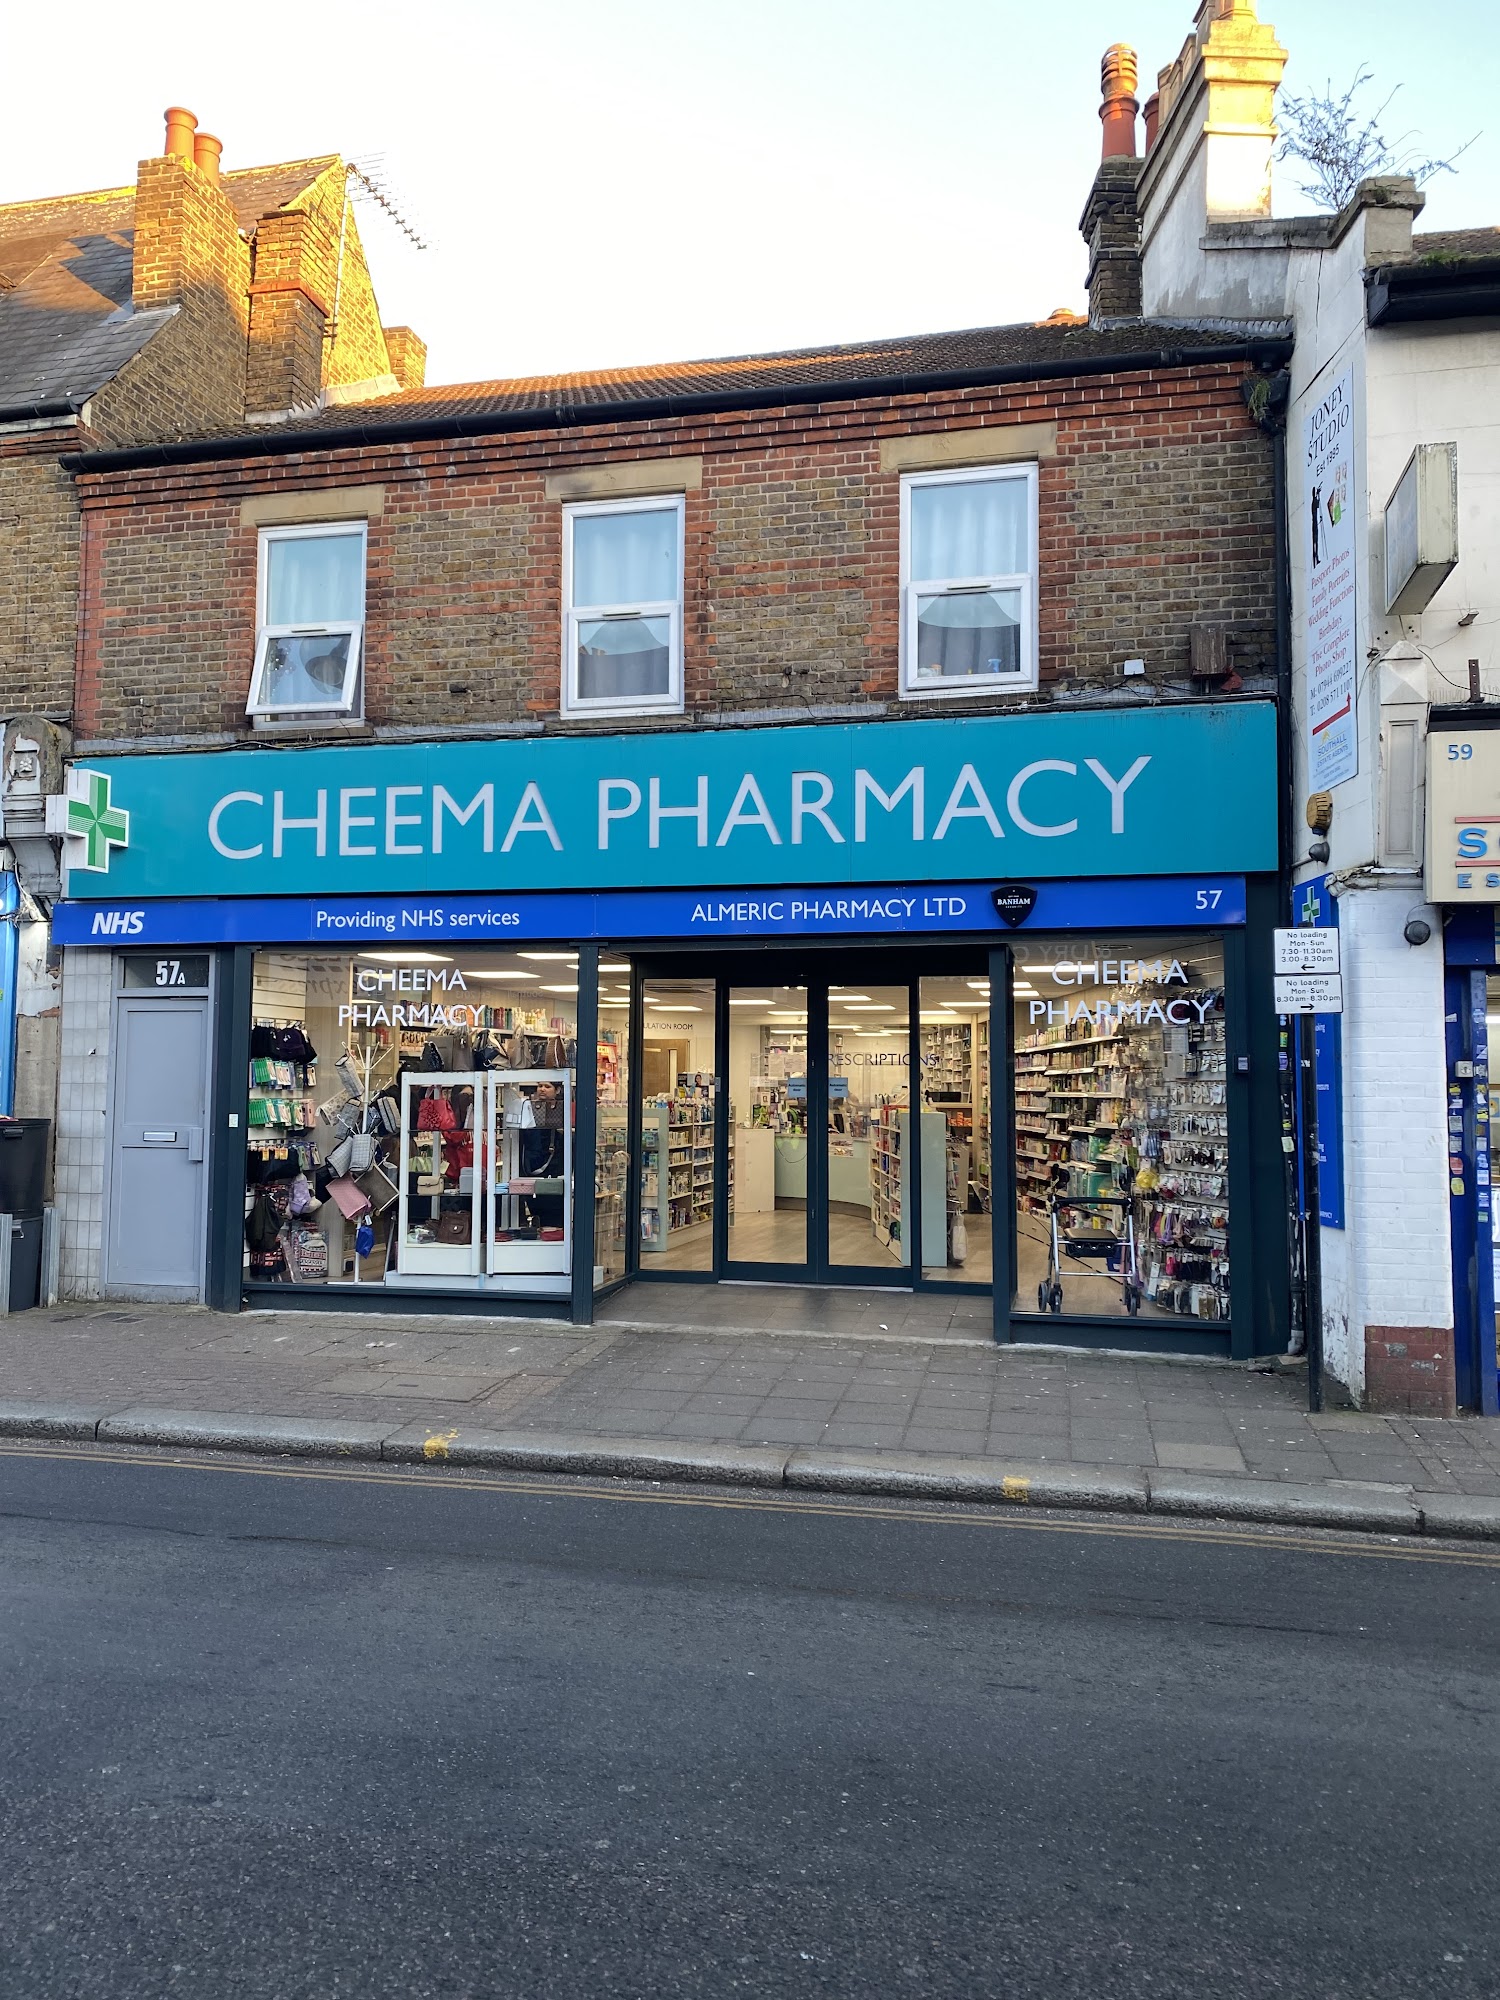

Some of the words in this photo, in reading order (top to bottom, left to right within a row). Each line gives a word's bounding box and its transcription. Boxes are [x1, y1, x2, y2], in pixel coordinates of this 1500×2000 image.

[1309, 378, 1346, 444] JONEY
[1307, 404, 1350, 467] STUDIO
[1316, 460, 1326, 477] Est
[1326, 443, 1340, 466] 1995
[1311, 565, 1331, 590] Passport
[1331, 548, 1350, 570] Photos
[1312, 587, 1328, 608] Family
[1328, 567, 1350, 593] Portraits
[1308, 604, 1329, 628] Wedding
[1329, 582, 1354, 611] Functions
[1318, 615, 1342, 640] Birthdays
[1311, 650, 1323, 664] The
[1323, 628, 1350, 654] Complete
[1315, 659, 1332, 677] Photo
[1332, 647, 1347, 664] Shop
[1447, 744, 1473, 761] 59
[208, 783, 562, 860] CHEEMA
[598, 756, 1152, 850] PHARMACY
[1458, 827, 1500, 859] S
[690, 901, 784, 922] ALMERIC
[791, 898, 917, 920] PHARMACY
[924, 897, 967, 917] LTD
[997, 897, 1031, 906] BANHAM
[1195, 890, 1223, 910] 57
[91, 911, 145, 935] NHS
[316, 909, 396, 933] Providing
[401, 909, 444, 927] NHS
[449, 910, 520, 927] services
[1300, 931, 1328, 939] loading
[155, 960, 186, 986] 57A
[357, 968, 467, 991] CHEEMA
[1051, 959, 1189, 985] CHEEMA
[338, 1004, 486, 1027] PHARMACY
[1029, 999, 1214, 1026] PHARMACY
